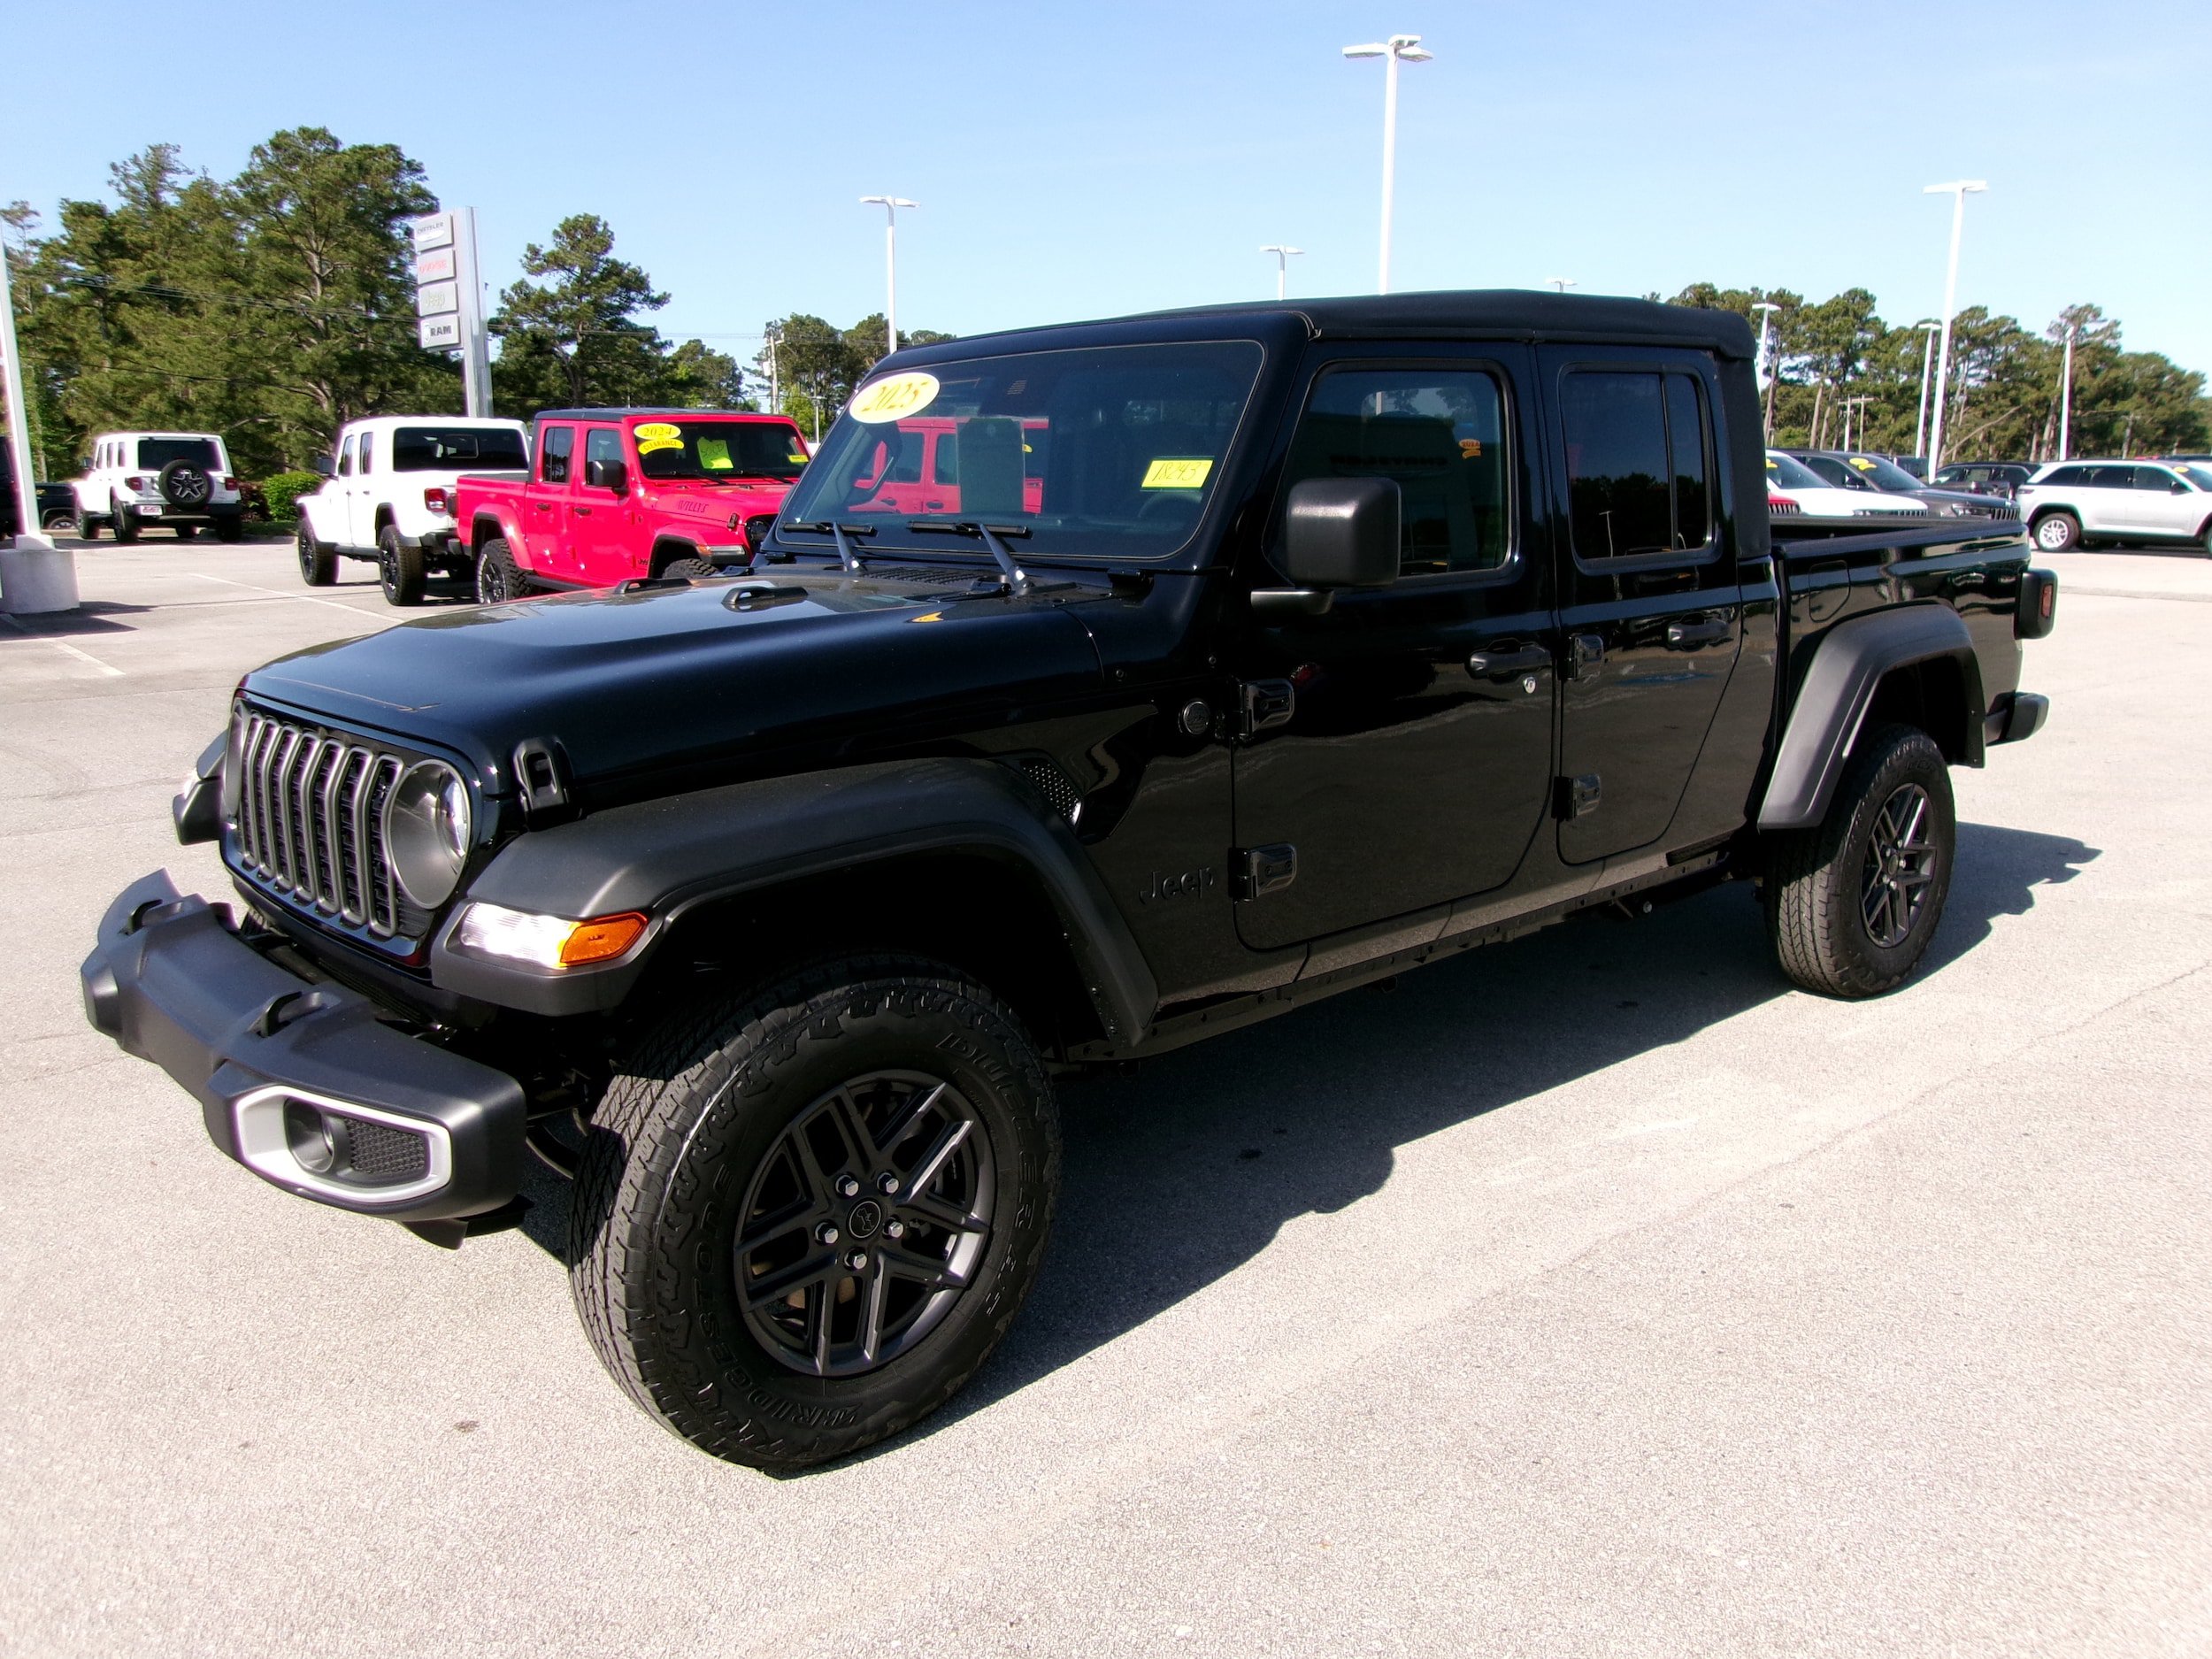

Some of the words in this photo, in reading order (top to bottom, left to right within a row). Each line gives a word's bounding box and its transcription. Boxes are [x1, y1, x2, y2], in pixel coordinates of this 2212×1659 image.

[430, 325, 452, 337] RAM
[861, 380, 930, 412] 2025
[643, 426, 672, 437] 2024
[678, 499, 709, 513] WILLYS
[1139, 866, 1214, 904] Jeep
[695, 1163, 864, 1427] BRIDGESTONE
